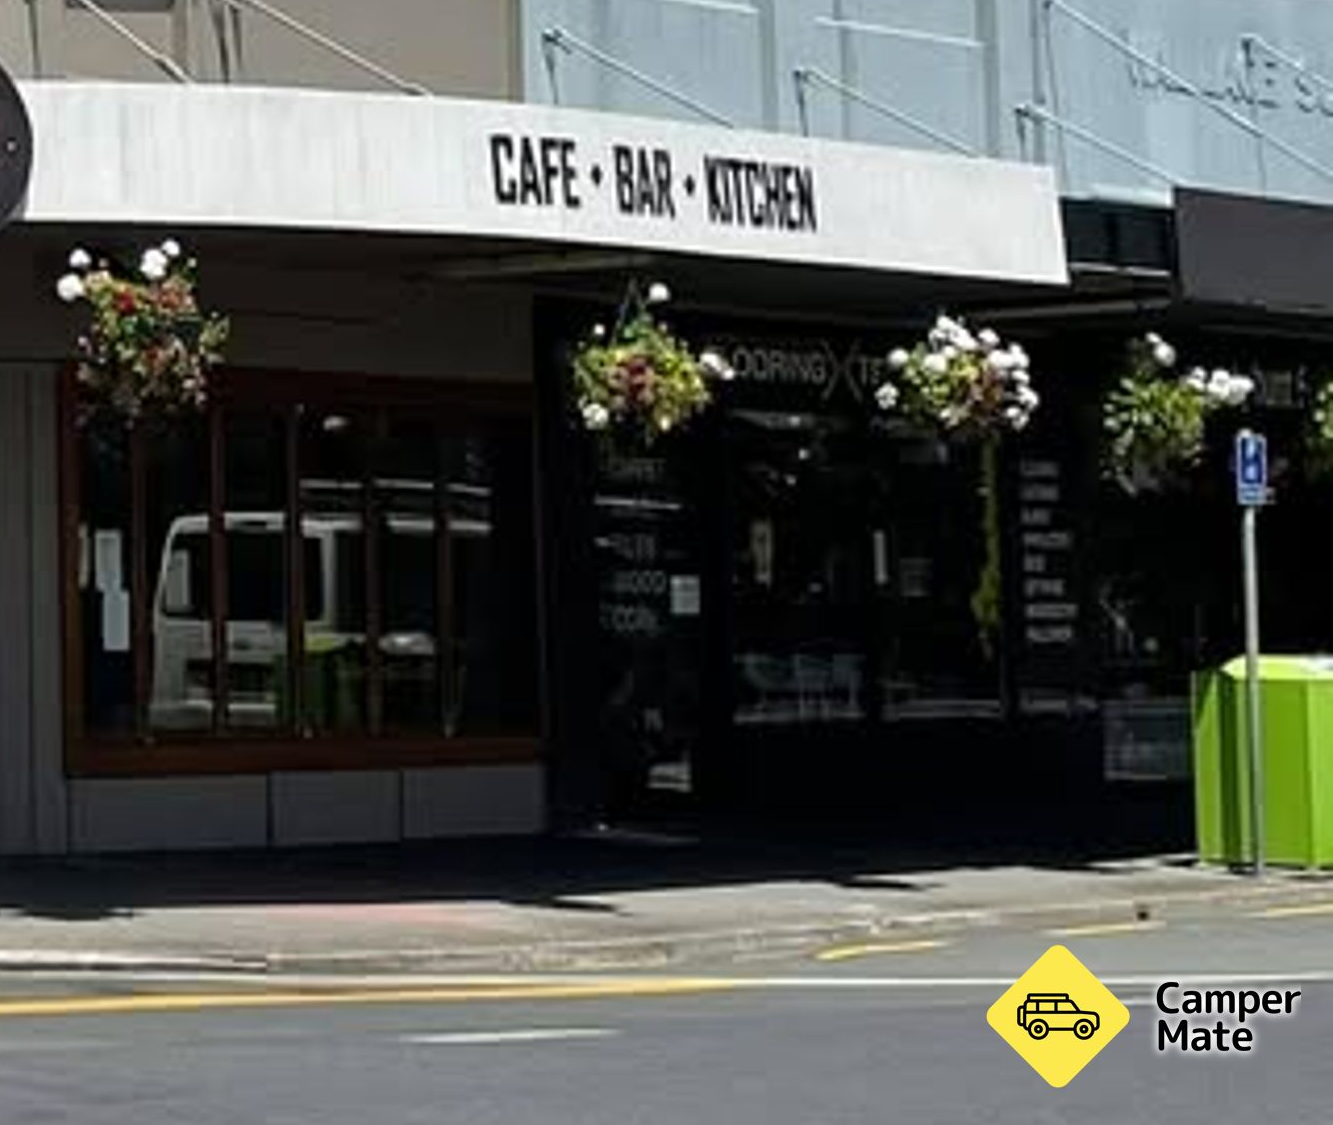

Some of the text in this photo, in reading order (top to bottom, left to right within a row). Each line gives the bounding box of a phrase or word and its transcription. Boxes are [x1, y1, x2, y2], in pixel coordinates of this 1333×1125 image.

[490, 134, 817, 232] CAFE BAR KITCHEN
[733, 345, 826, 385] OORING
